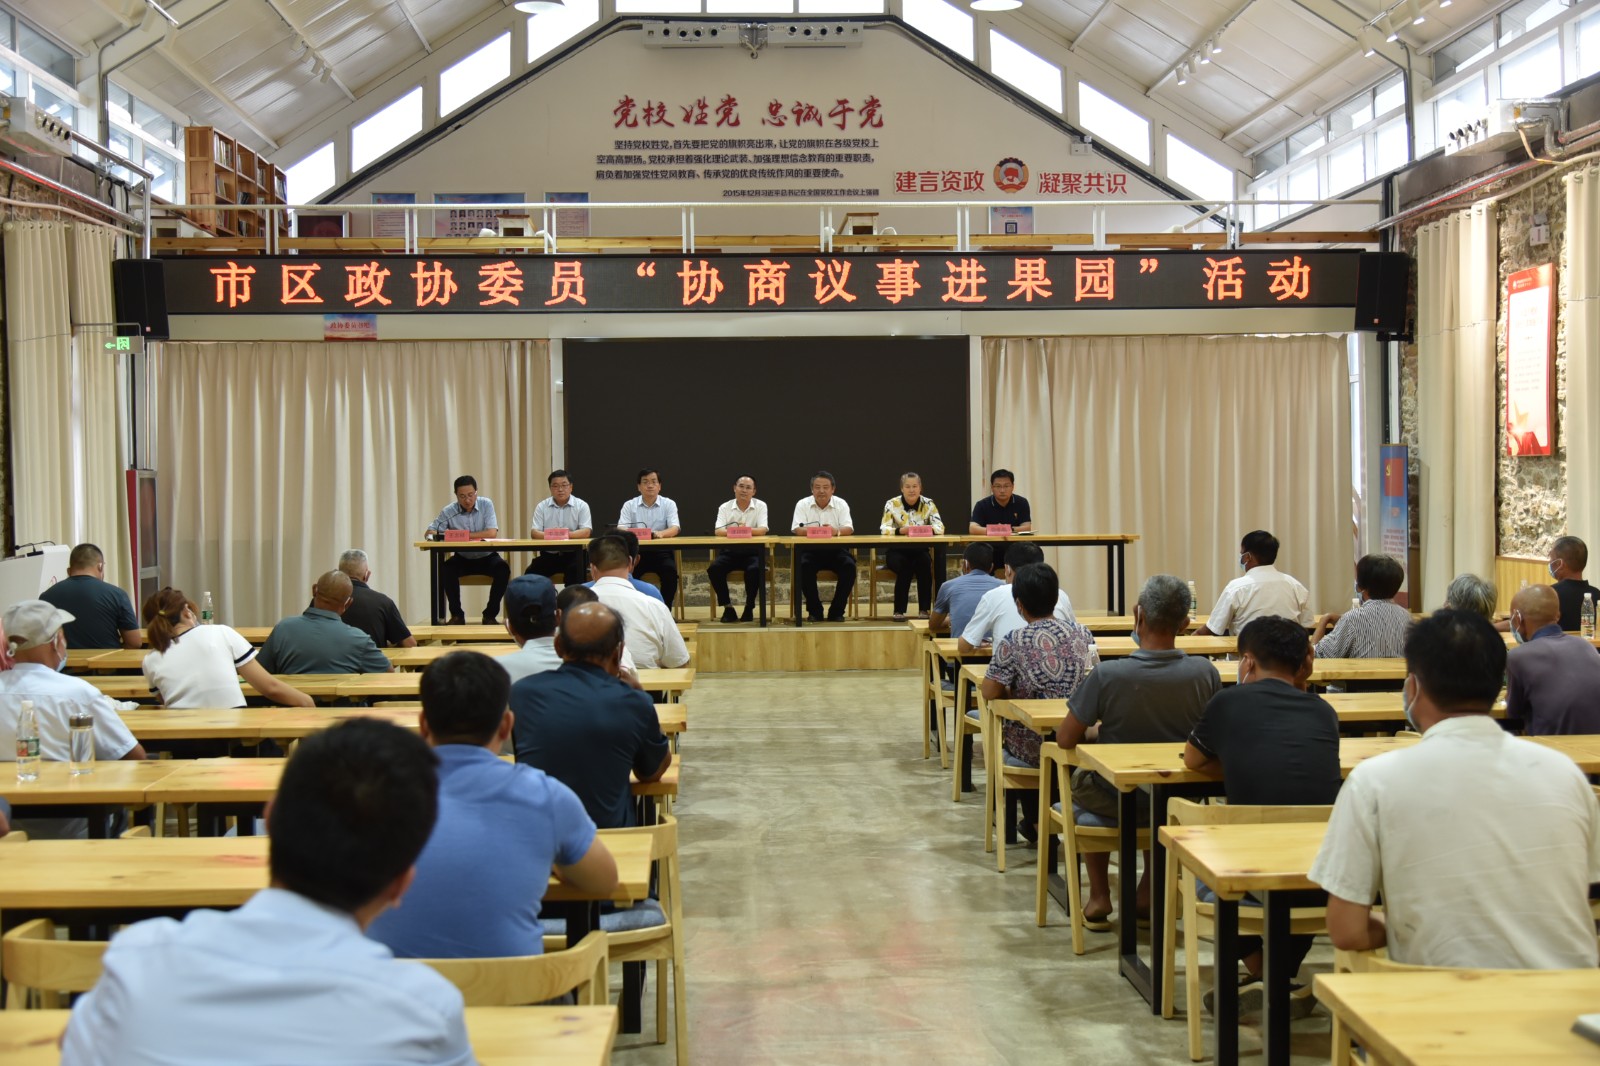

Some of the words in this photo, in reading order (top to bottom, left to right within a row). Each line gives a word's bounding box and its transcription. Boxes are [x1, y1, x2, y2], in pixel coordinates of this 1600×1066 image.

[613, 94, 740, 128] 党校姓党
[761, 95, 884, 130] 忠诚于党
[895, 170, 985, 193] 建言资政
[1038, 172, 1127, 195] 凝聚共识
